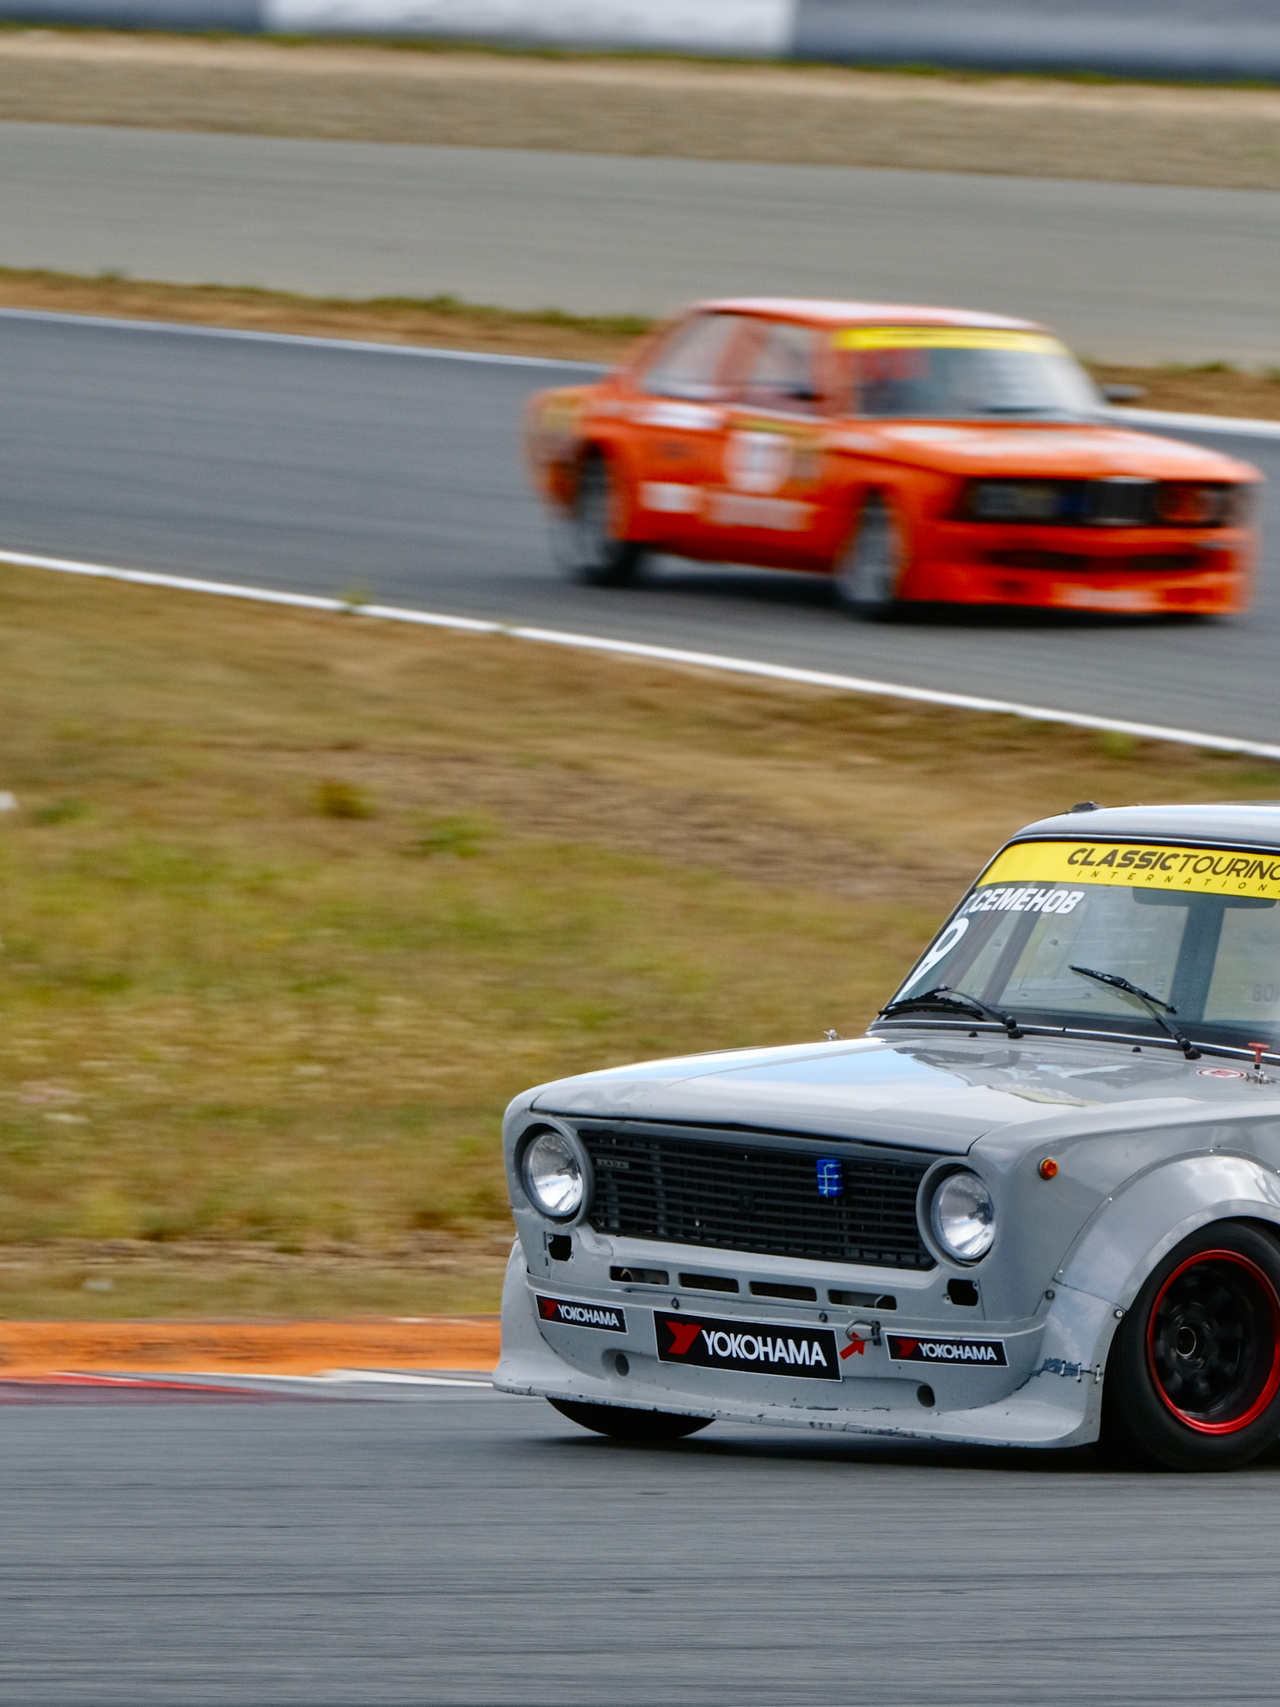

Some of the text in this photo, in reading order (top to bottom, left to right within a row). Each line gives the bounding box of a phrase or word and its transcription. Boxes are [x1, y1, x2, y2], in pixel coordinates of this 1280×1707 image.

[557, 1304, 620, 1327] YOKOHAMA
[701, 1329, 828, 1367] YOKOHAMA
[918, 1342, 997, 1360] YOKOHAMA
